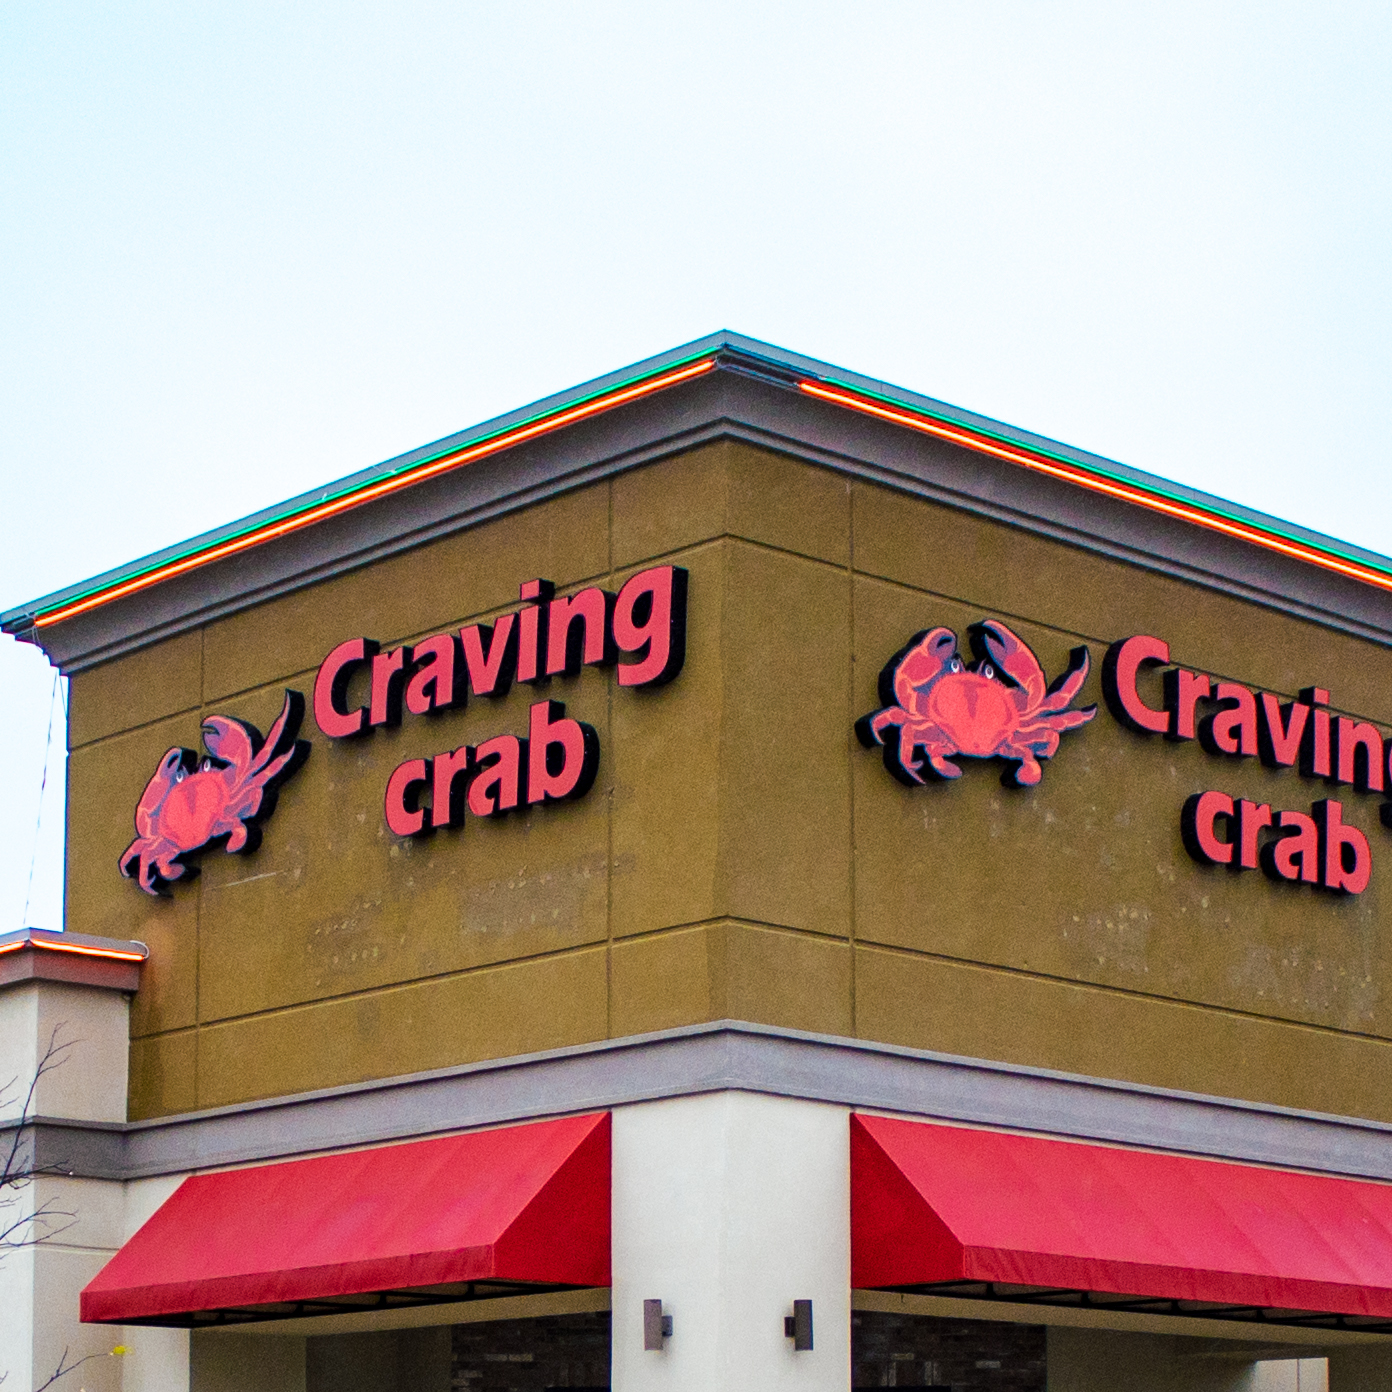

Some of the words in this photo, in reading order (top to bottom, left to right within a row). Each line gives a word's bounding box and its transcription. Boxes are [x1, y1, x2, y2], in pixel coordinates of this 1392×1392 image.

[313, 564, 688, 740] Craving
[384, 699, 600, 838] crab
[1180, 790, 1372, 896] crab
